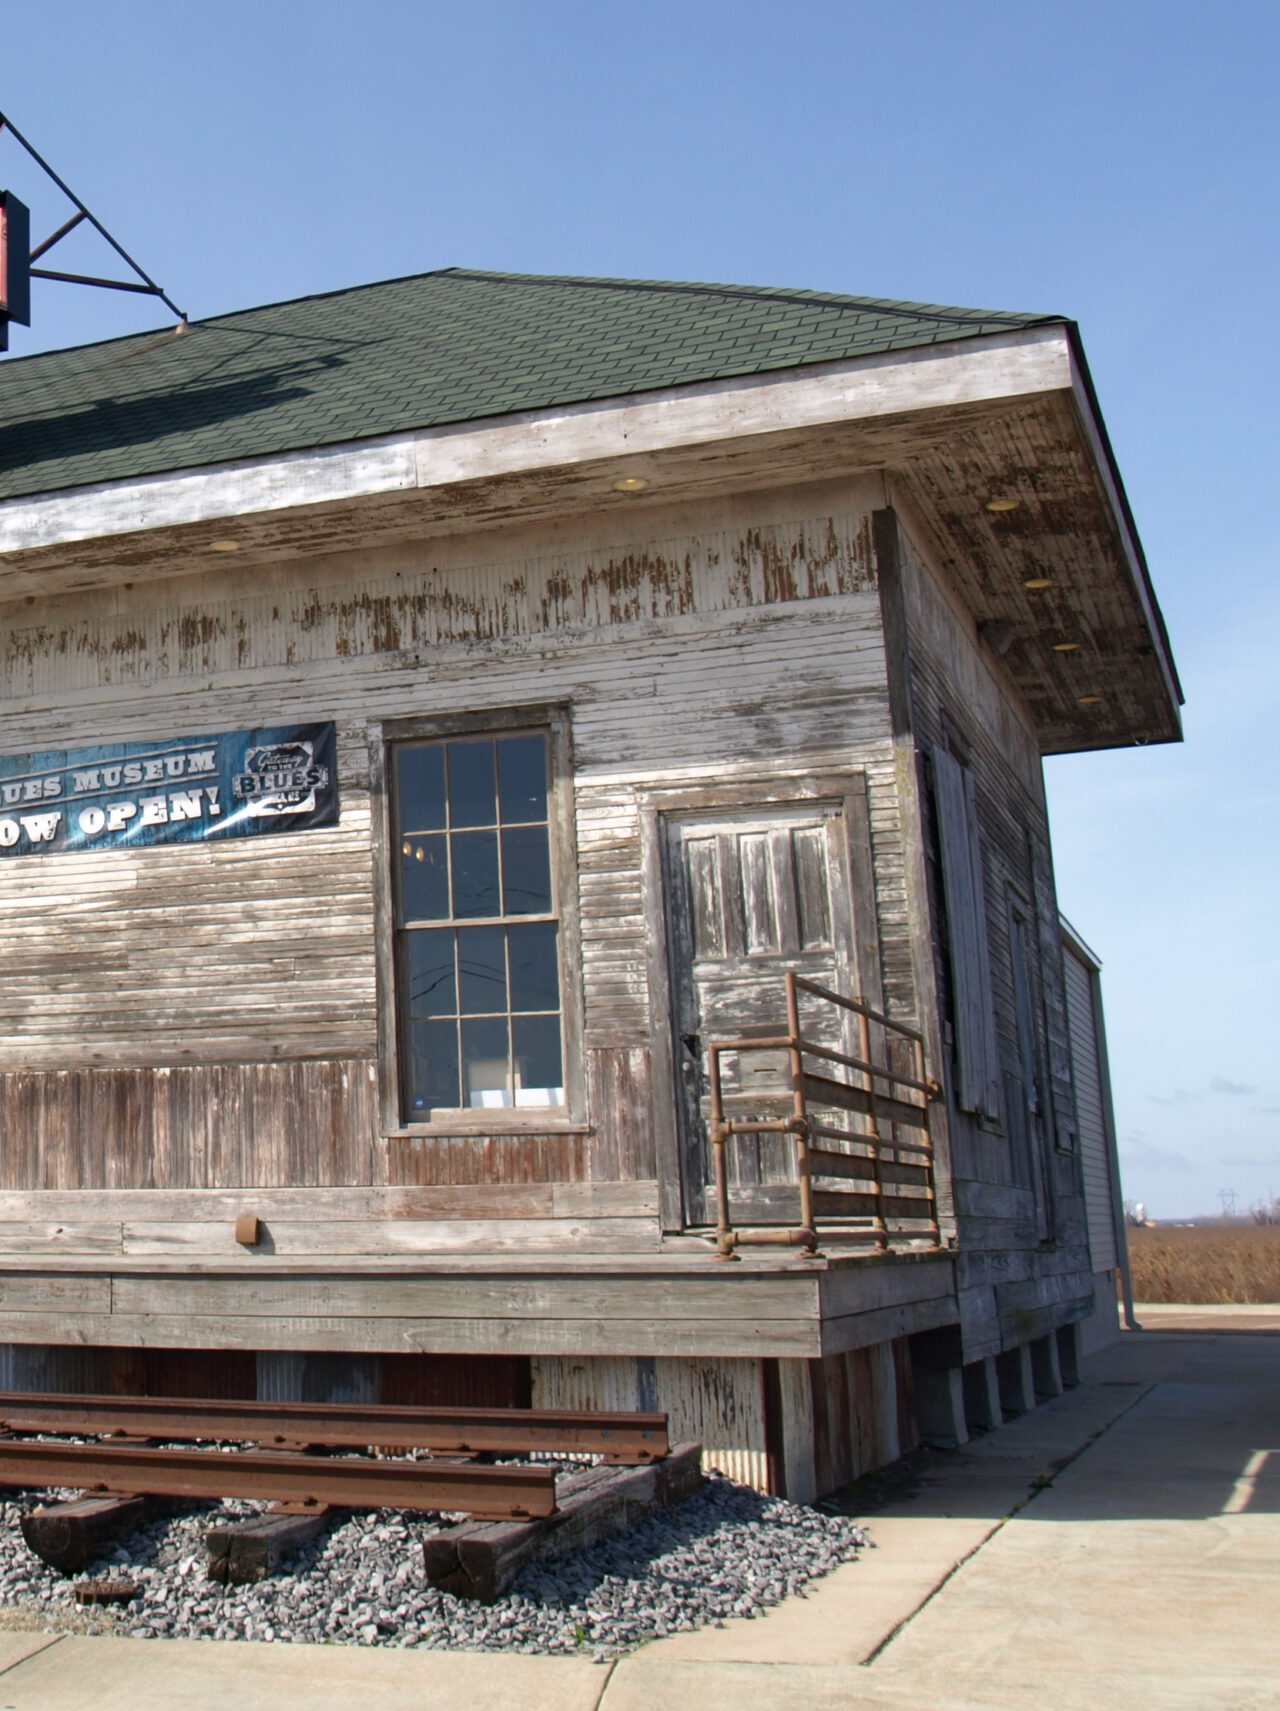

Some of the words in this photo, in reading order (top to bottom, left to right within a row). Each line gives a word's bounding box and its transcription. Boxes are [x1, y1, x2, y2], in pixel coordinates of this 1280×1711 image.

[73, 750, 216, 793] MUSEUM
[257, 751, 304, 773] Gateway
[240, 767, 322, 794] BLUES
[78, 787, 221, 834] OPEN!
